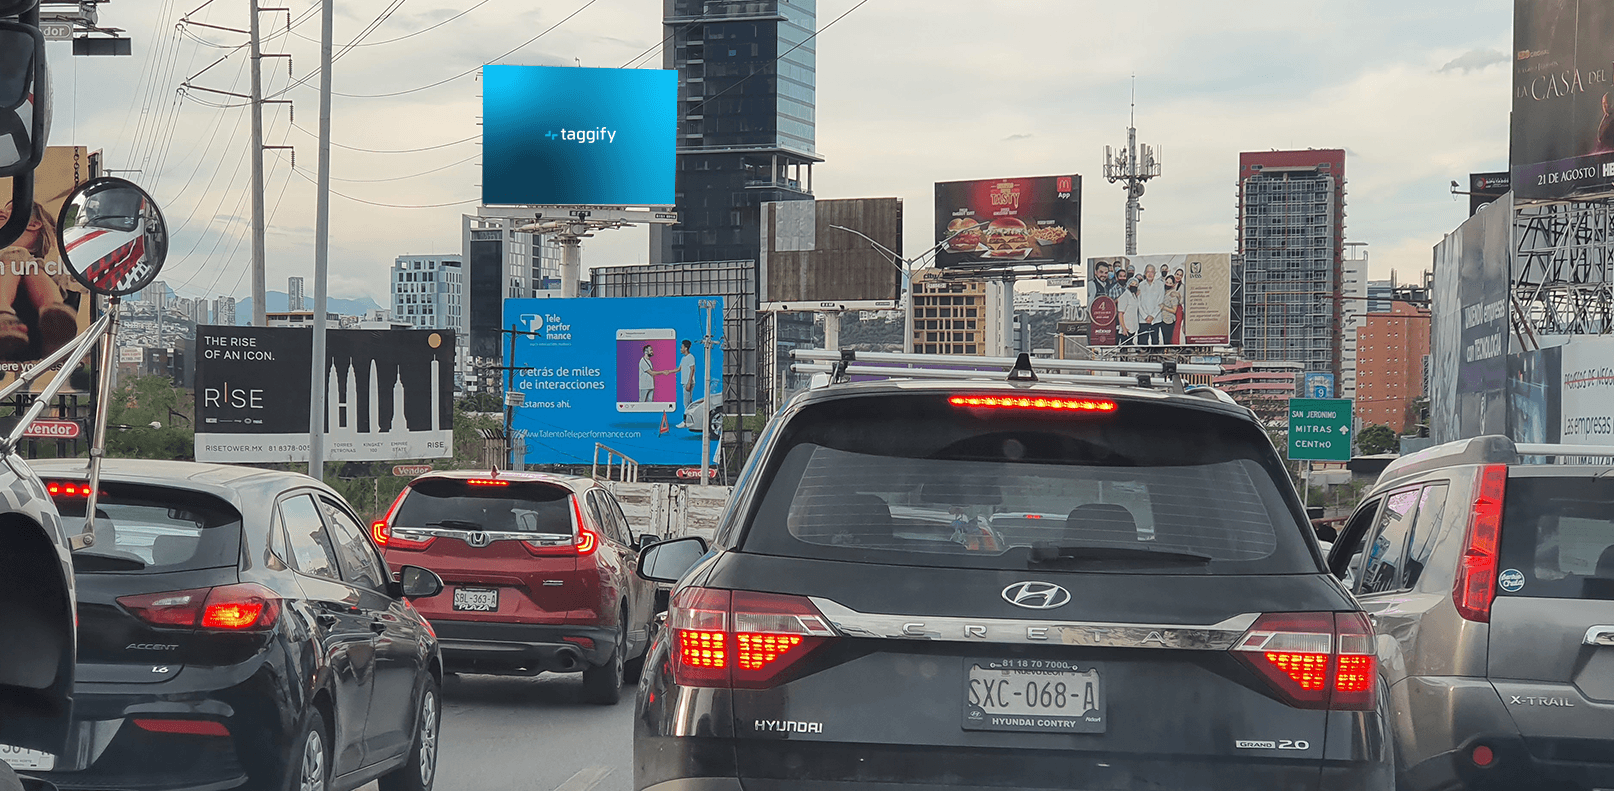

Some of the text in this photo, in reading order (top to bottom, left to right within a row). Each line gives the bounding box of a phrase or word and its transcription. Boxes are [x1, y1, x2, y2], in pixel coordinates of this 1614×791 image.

[1532, 69, 1584, 100] CASA
[1589, 69, 1606, 84] DEL
[561, 127, 616, 143] taggify
[1538, 175, 1546, 185] 21
[1549, 172, 1559, 184] DE
[1561, 167, 1595, 181] AGOSTO
[991, 192, 1020, 208] TASTY
[11, 261, 38, 275] un
[545, 314, 561, 322] Tele
[547, 323, 570, 332] perfor
[205, 336, 256, 347] THE RISE
[205, 350, 275, 360] OF AN ICON.
[557, 367, 569, 376] de
[572, 367, 600, 376] miles
[520, 380, 605, 389] de interacciones
[205, 382, 263, 409] RISE
[1319, 389, 1324, 397] 9
[27, 424, 72, 434] Vendor
[1564, 414, 1611, 440] Las empresas
[1296, 440, 1331, 448] CENTRO
[456, 593, 495, 604] SBL-363-A
[903, 623, 1167, 644] CRETA
[969, 679, 1095, 710] SXC-068-A
[1511, 696, 1574, 707] X-TRAIL
[755, 720, 822, 733] HYUNDAI
[992, 718, 1034, 726] HYUNDAI
[1037, 719, 1076, 727] CONTRY
